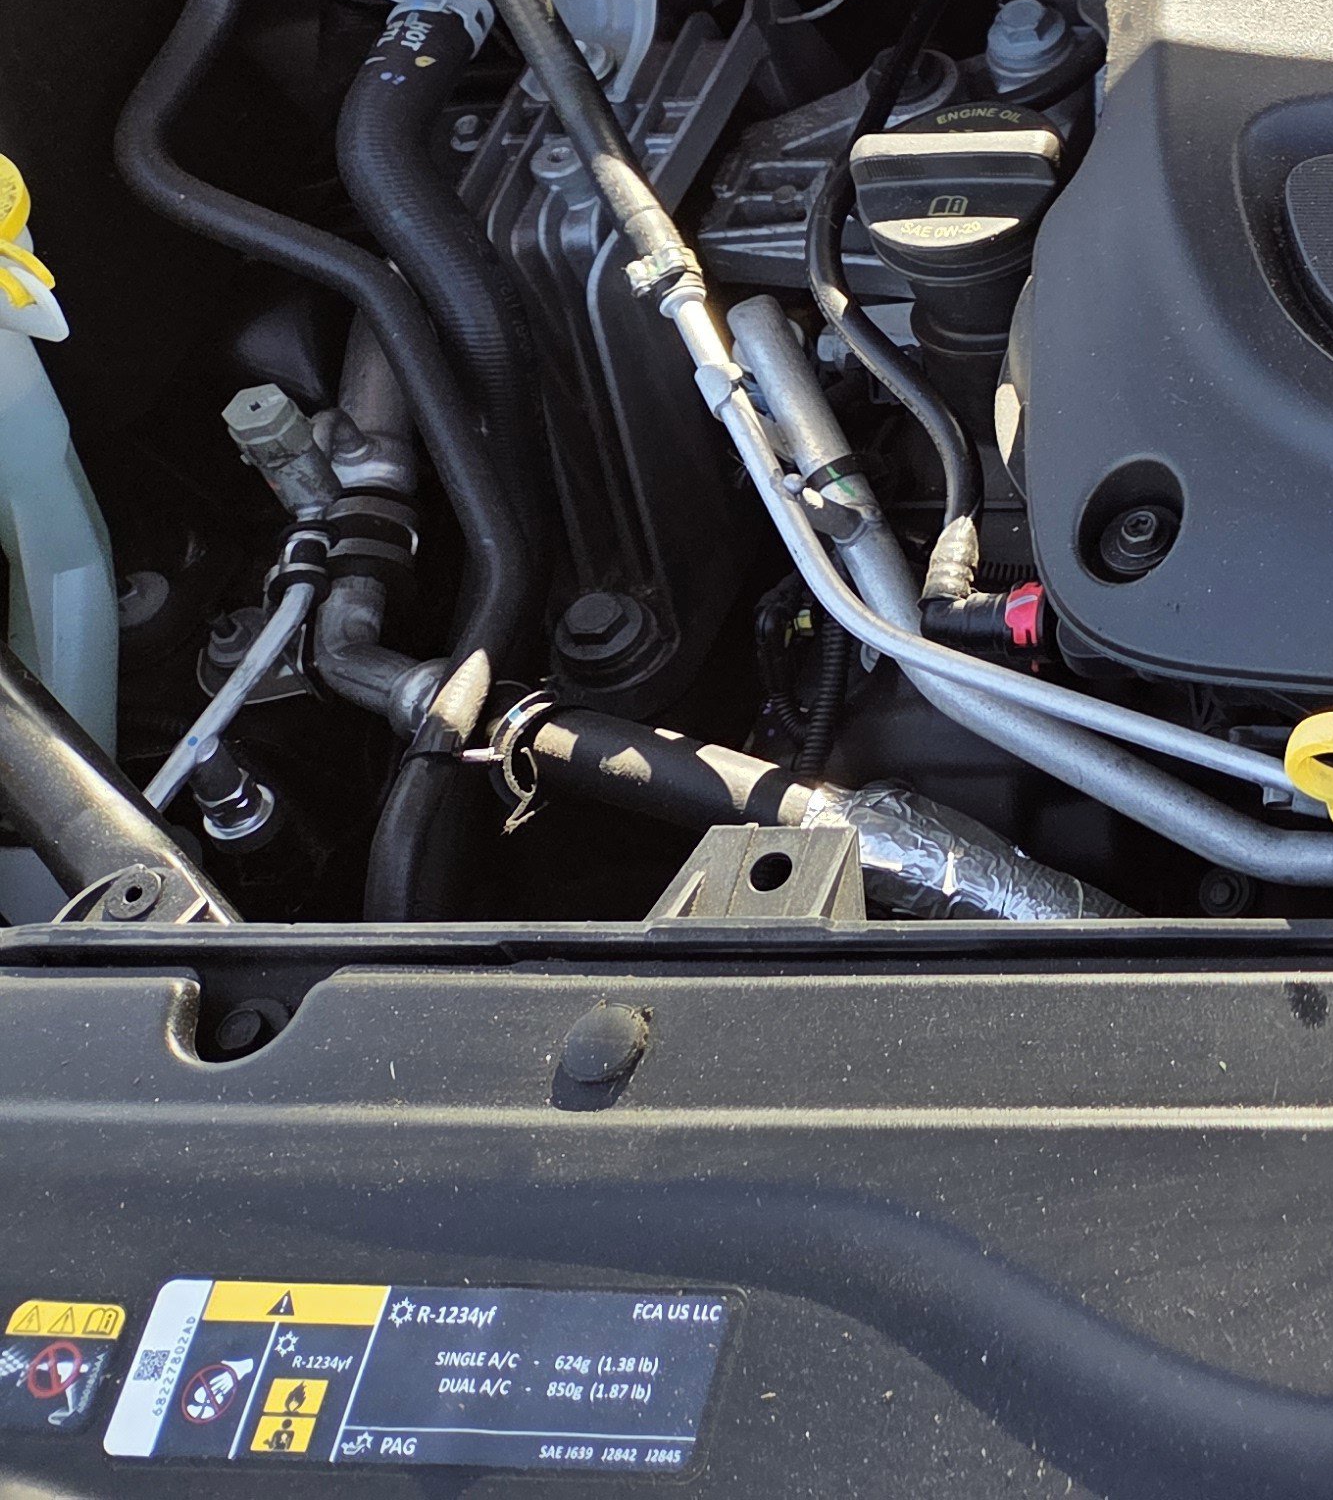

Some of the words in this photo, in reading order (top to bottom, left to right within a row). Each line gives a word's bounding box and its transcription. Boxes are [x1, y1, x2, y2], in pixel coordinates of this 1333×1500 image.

[935, 107, 998, 125] ENGINE
[999, 108, 1022, 124] OIL
[900, 220, 933, 238] SAE
[933, 220, 983, 238] 0W-20
[416, 1305, 498, 1329] R-1234yf
[632, 1303, 664, 1320] FCA
[667, 1304, 690, 1320] US
[692, 1304, 722, 1321] LLC
[291, 1355, 354, 1373] R-1234yf
[434, 1351, 487, 1367] SINGLE
[488, 1350, 520, 1370] A/C
[554, 1355, 592, 1374] 624g
[597, 1355, 636, 1376] (1.38
[637, 1356, 659, 1376] lb)
[438, 1377, 476, 1393] DUAL
[479, 1377, 512, 1397] A/C
[546, 1381, 584, 1401] 850g
[589, 1381, 629, 1402] (1.87
[630, 1383, 652, 1404] lb)
[380, 1436, 418, 1456] PAG
[538, 1444, 563, 1460] SAE
[564, 1446, 594, 1461] J639
[601, 1447, 638, 1463] J2842
[644, 1448, 682, 1464] J2845
